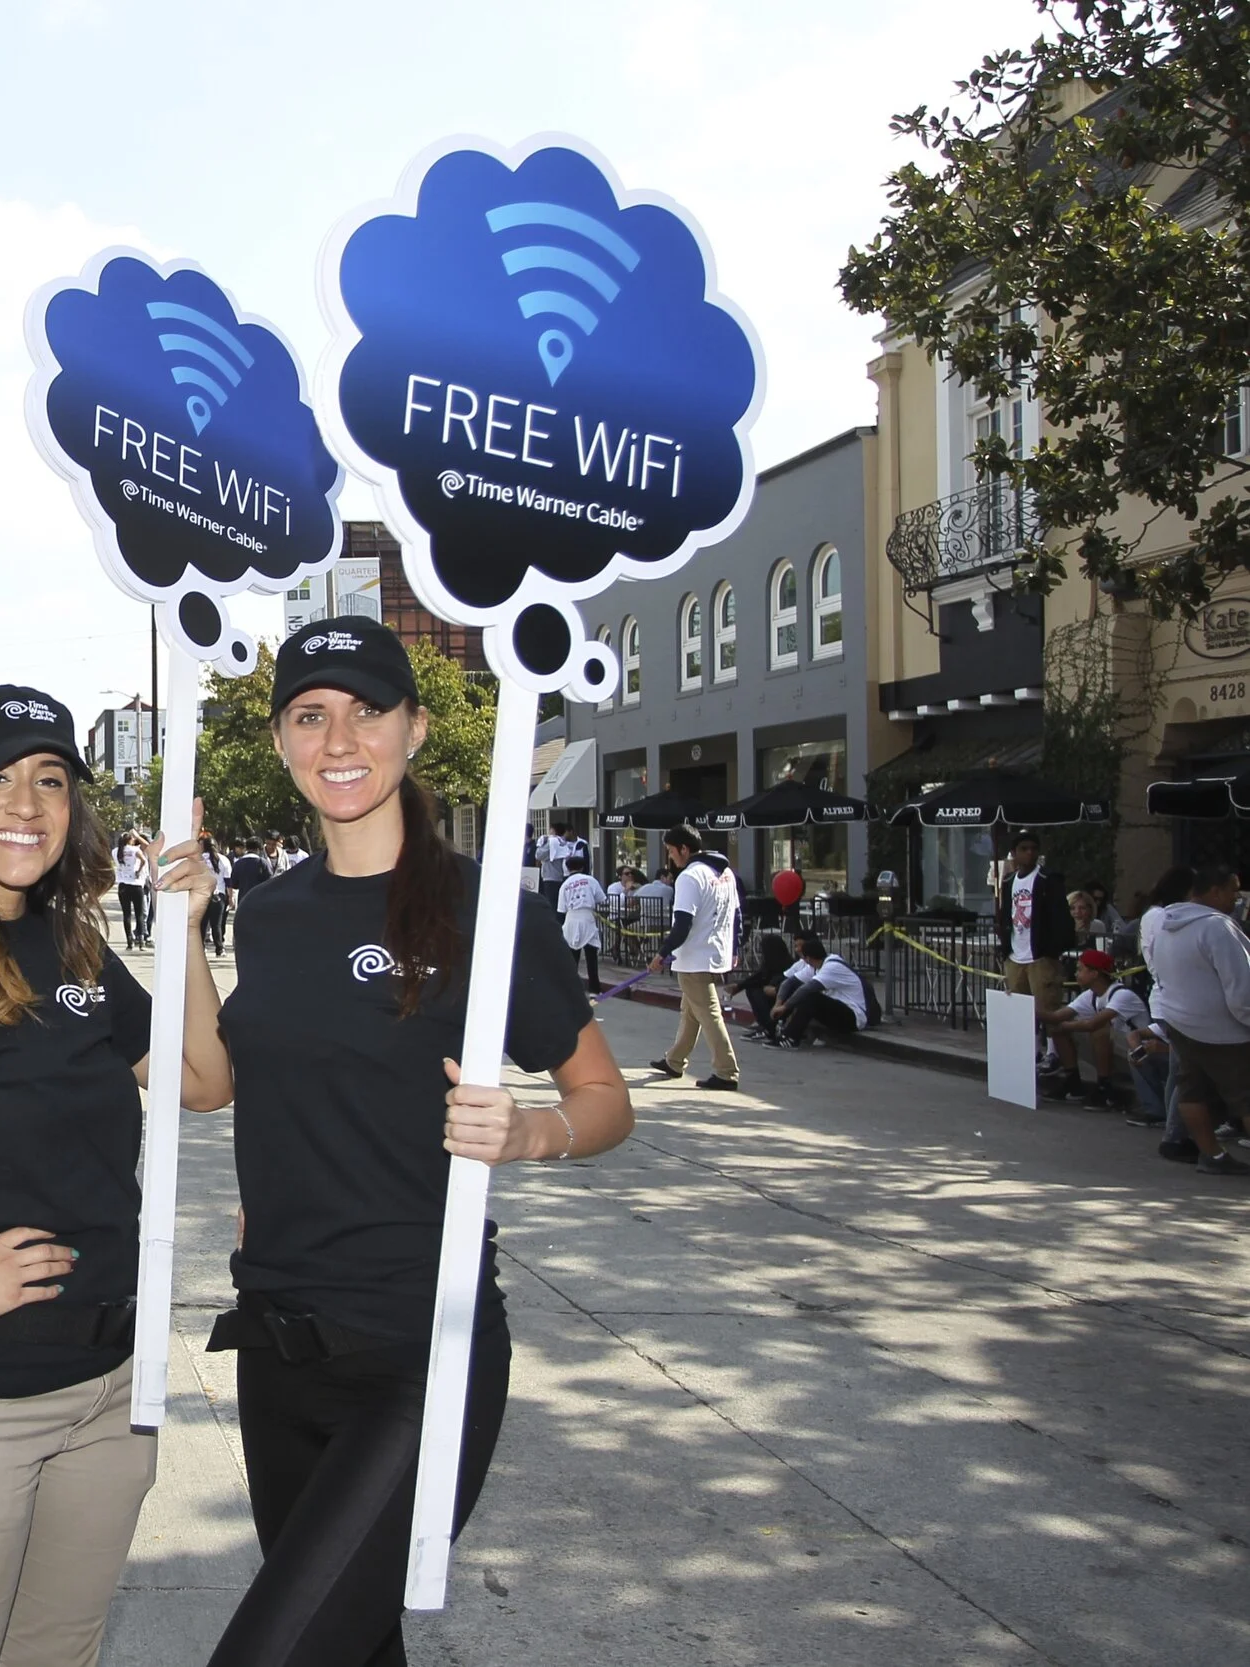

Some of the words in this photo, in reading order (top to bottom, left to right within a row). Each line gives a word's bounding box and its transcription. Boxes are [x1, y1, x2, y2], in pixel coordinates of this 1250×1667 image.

[403, 374, 558, 469] FREE
[573, 414, 682, 498] WiFi
[94, 404, 203, 495] FREE
[214, 460, 291, 536] WiFi
[465, 473, 514, 504] Time
[516, 484, 585, 520] Warner
[139, 484, 175, 515] Time
[176, 501, 226, 537] Warner
[338, 568, 378, 576] QUARTER
[1203, 608, 1248, 631] Kate
[1209, 682, 1246, 701] 8428
[822, 806, 855, 816] ALFRED
[935, 807, 982, 817] ALFRED
